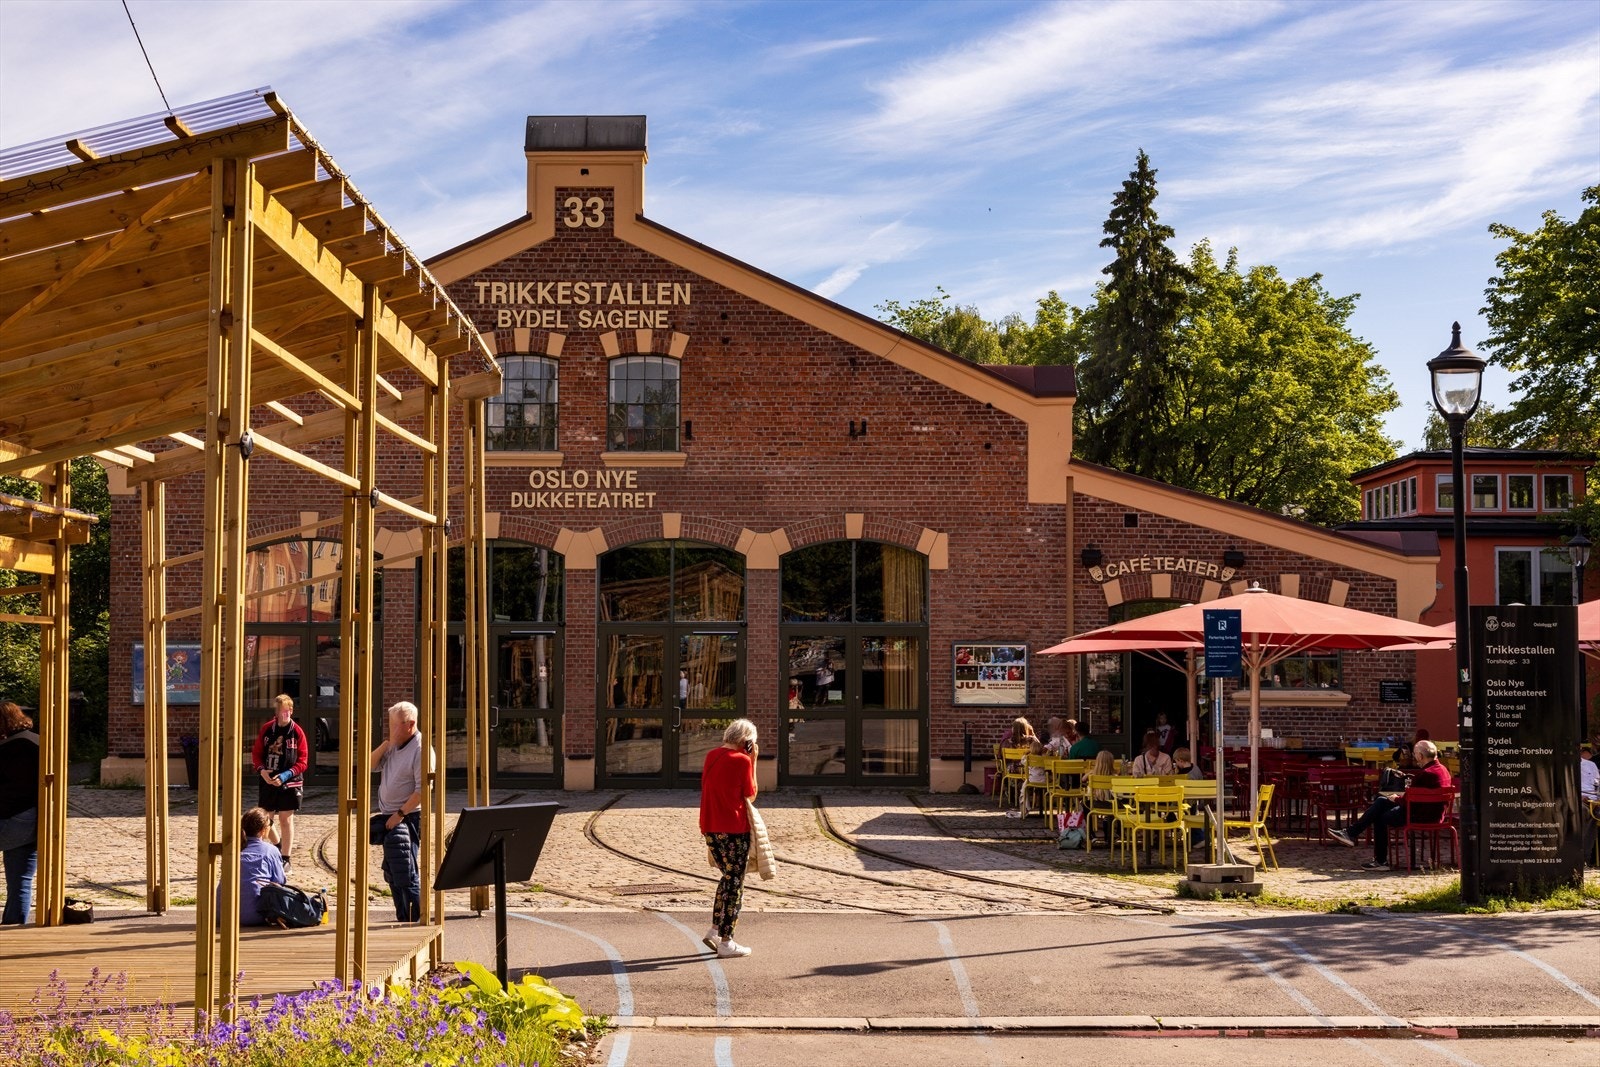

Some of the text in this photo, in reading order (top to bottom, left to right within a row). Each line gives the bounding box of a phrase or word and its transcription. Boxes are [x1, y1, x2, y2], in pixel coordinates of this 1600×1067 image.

[563, 196, 606, 228] 33
[474, 281, 691, 305] TRIKKESTALLEN
[497, 309, 669, 329] BYDEL SAGENE
[529, 469, 638, 489] OSLO NYE
[511, 492, 656, 509] DUKKETEATRET
[1105, 553, 1219, 579] CAFÉ TEATER
[1486, 645, 1555, 655] Trikkestallen
[956, 681, 985, 690] JUL
[1508, 679, 1525, 688] Nye
[1486, 689, 1547, 697] Dukketeateret
[1487, 737, 1512, 746] Bydel
[1487, 747, 1553, 756] Sagene-Torshov
[1489, 786, 1532, 795] Fremja AS
[1497, 801, 1556, 809] Fremja Dagsenter
